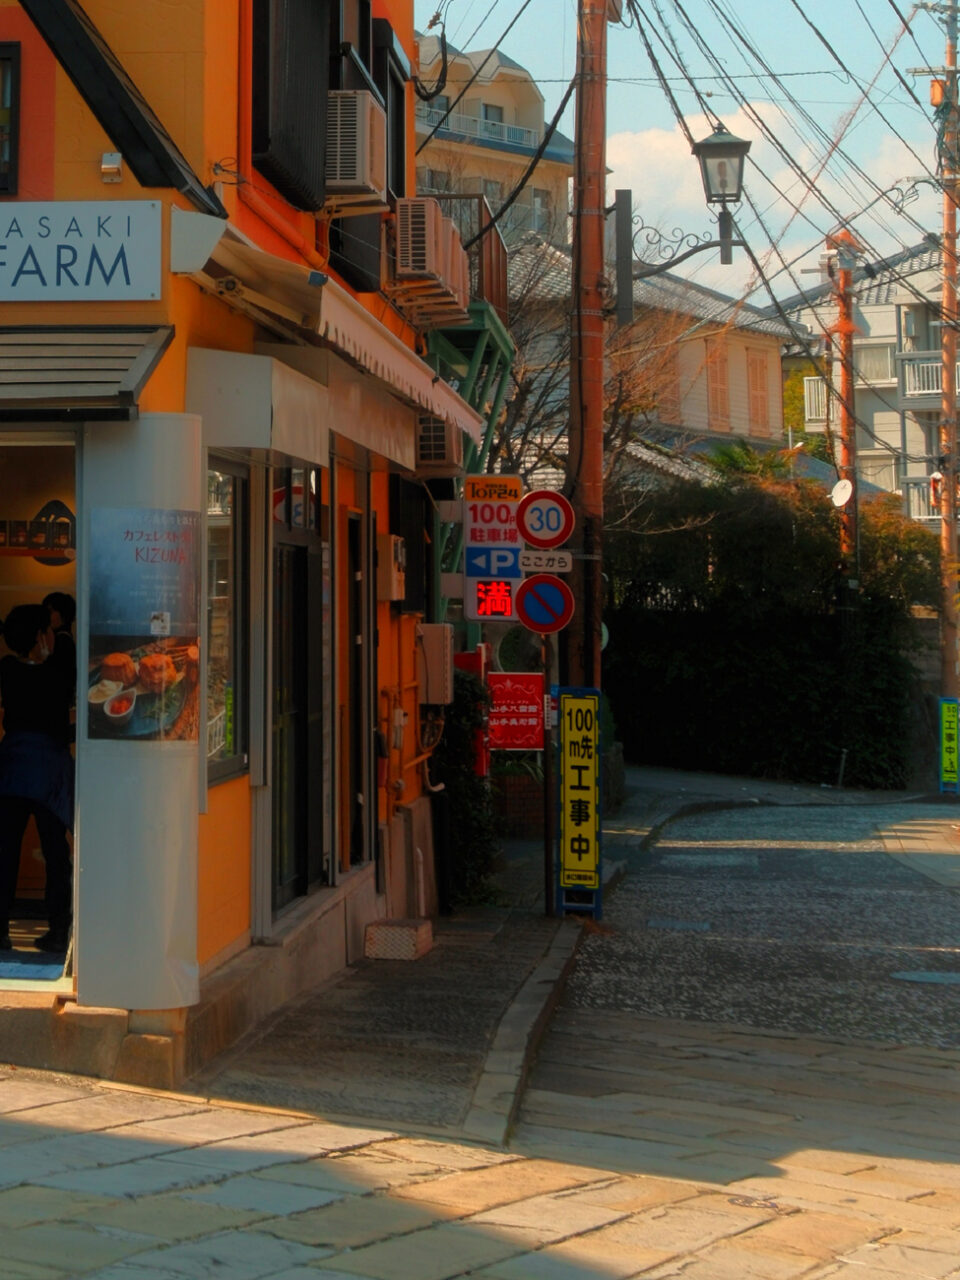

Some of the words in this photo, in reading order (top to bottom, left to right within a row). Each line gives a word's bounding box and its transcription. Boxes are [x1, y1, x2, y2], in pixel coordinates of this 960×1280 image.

[530, 507, 561, 532] 30
[470, 528, 518, 543] 駐車場
[136, 546, 186, 565] KIZUNA
[491, 550, 515, 575] P
[521, 556, 568, 568] ここから
[477, 581, 513, 616] 満
[567, 708, 593, 732] 100
[569, 735, 593, 759] m先
[569, 766, 590, 862] 工事中
